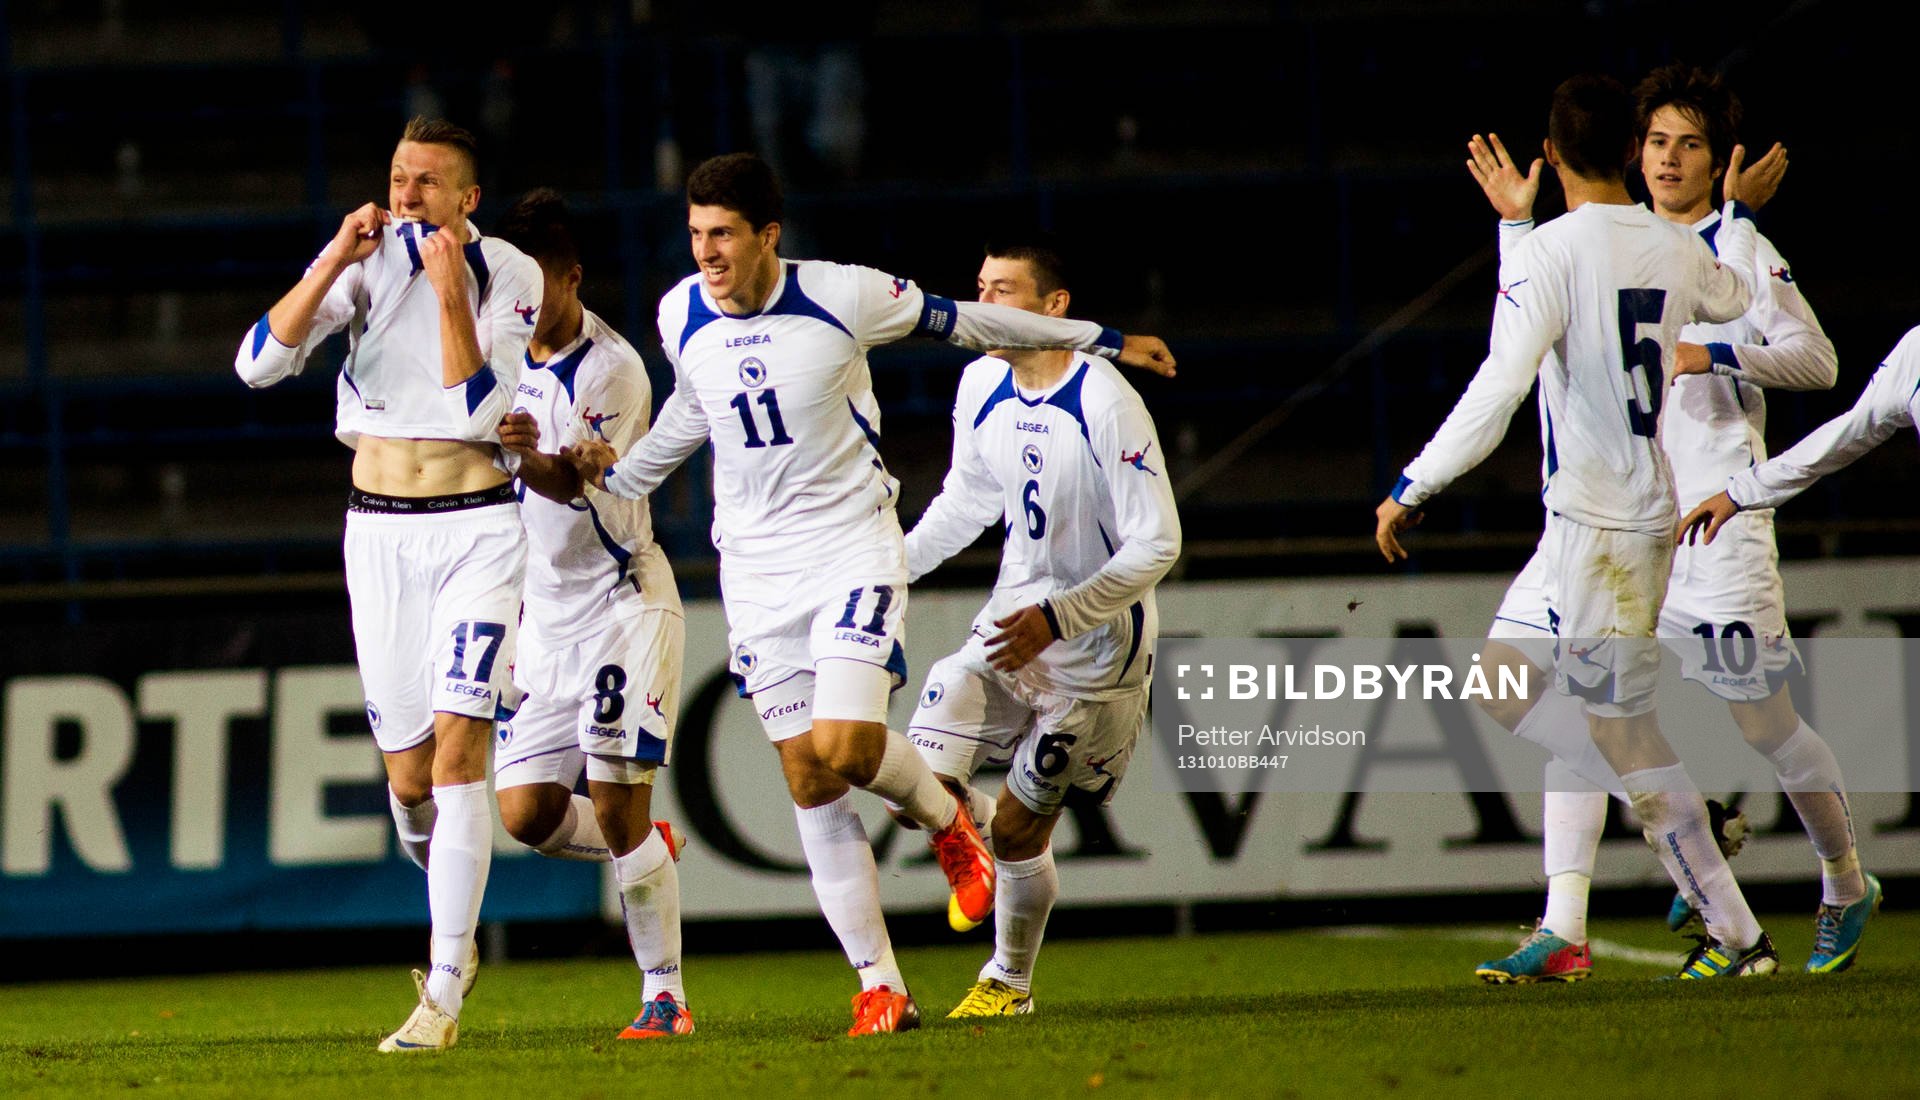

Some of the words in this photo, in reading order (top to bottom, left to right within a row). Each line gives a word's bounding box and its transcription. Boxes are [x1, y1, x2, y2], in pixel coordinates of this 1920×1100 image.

[725, 334, 771, 348] LEGEA
[1617, 288, 1667, 438] 5
[517, 383, 544, 400] EGEA
[730, 388, 794, 449] 11
[1016, 421, 1049, 435] LEGEA
[362, 495, 387, 507] Calvin
[392, 500, 412, 510] Klein
[427, 500, 458, 510] Calvin
[463, 495, 486, 506] Klein
[1023, 479, 1046, 540] 6
[834, 585, 894, 637] 11
[834, 631, 880, 649] LEGEA
[1692, 621, 1757, 676] 10
[446, 621, 506, 683] 17
[1712, 675, 1758, 687] LEGEA
[445, 682, 492, 700] LEGEA
[593, 664, 627, 724] 8
[773, 700, 807, 718] LEGEA
[584, 723, 627, 740] LEGEA
[912, 736, 945, 752] LEGEA
[1035, 733, 1077, 778] 6
[1023, 763, 1060, 794] LEGEA
